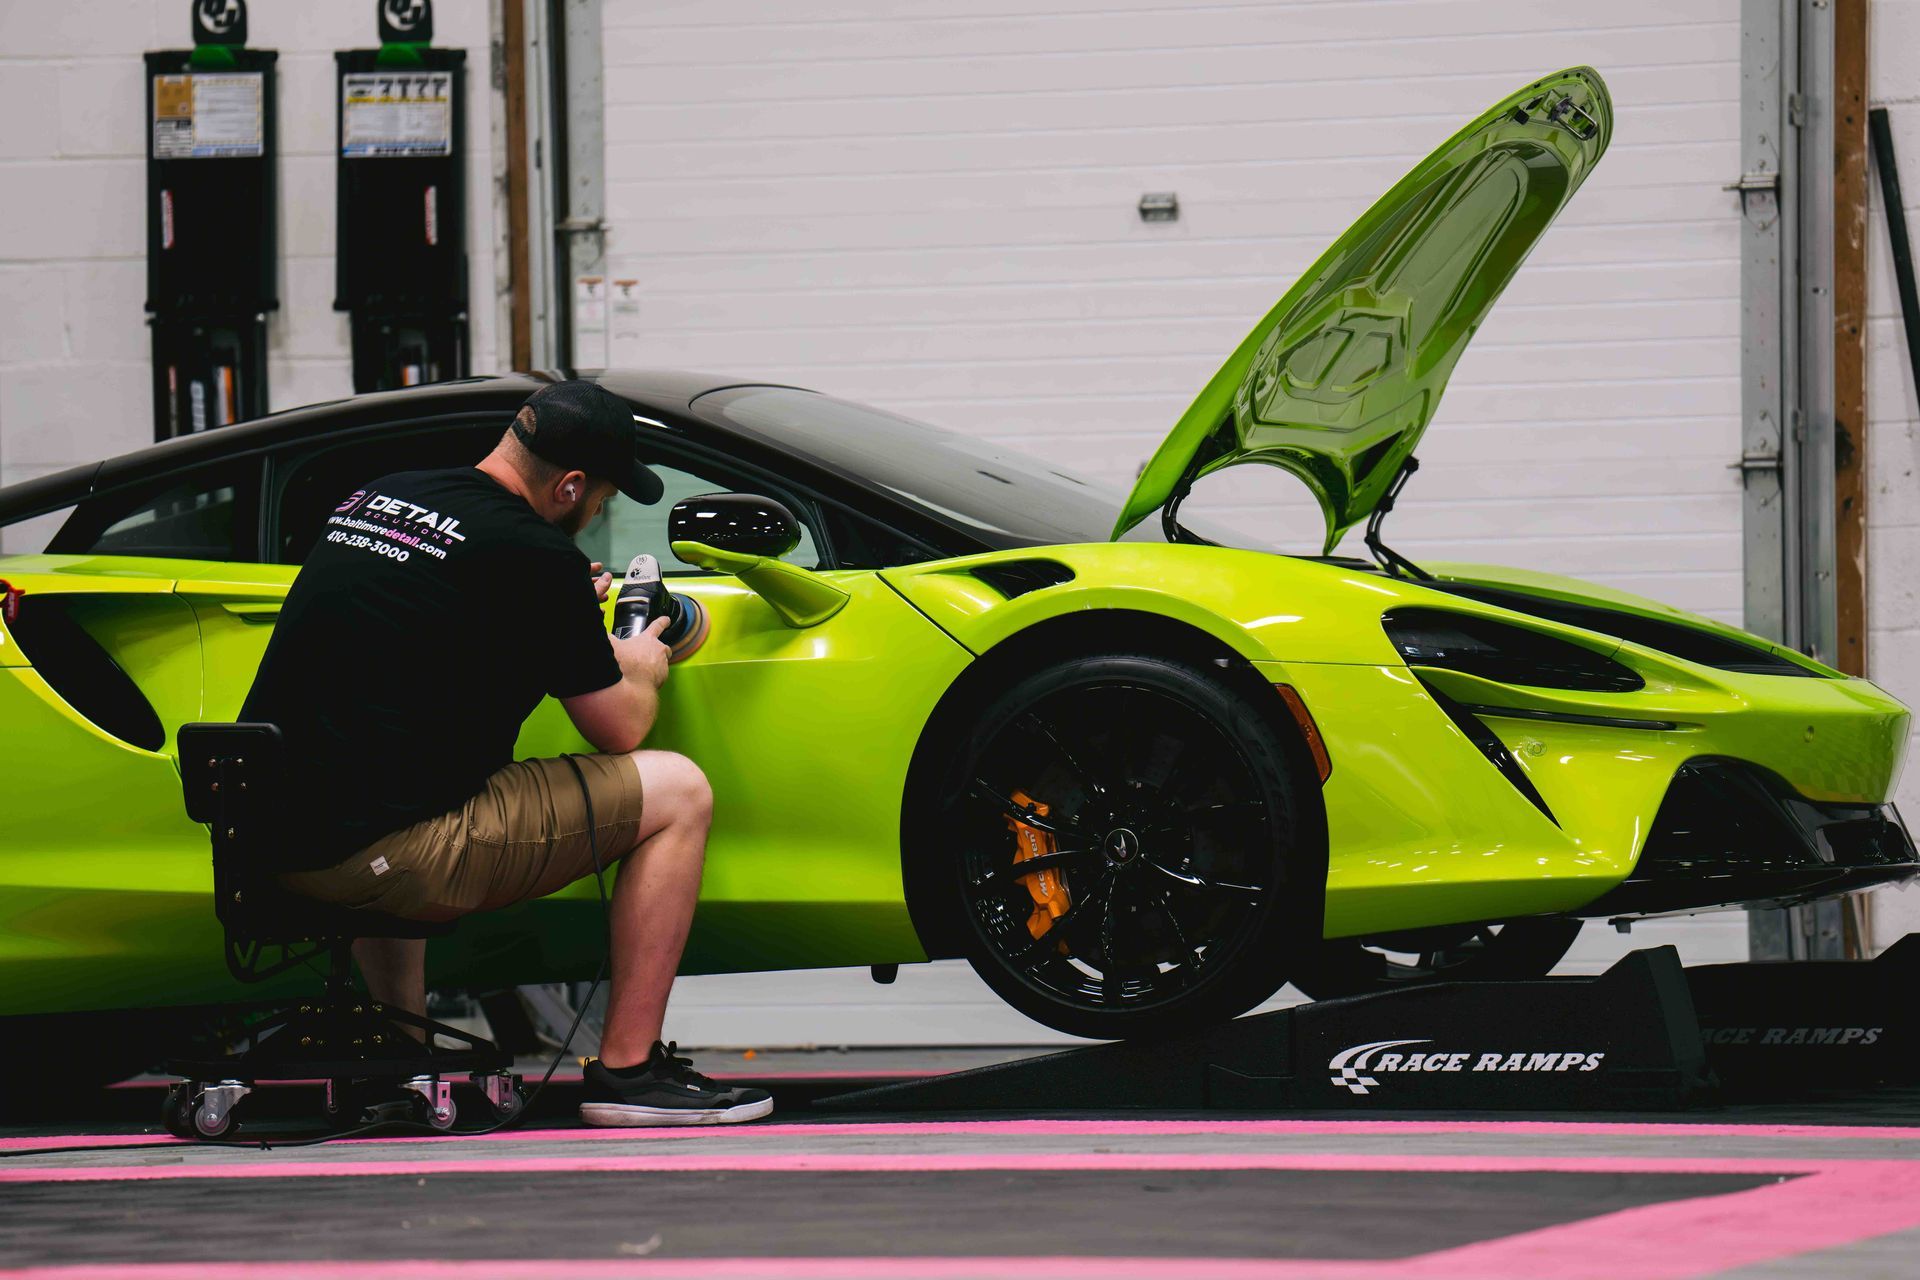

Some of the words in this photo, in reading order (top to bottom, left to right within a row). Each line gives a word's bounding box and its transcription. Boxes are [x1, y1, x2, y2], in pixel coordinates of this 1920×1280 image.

[364, 510, 453, 545] SOLUTIONS
[366, 494, 466, 542] DETAIL
[326, 530, 410, 562] 410-238-3000
[1699, 1027, 1757, 1045] ACE
[1759, 1027, 1884, 1045] RAMPS
[1372, 1052, 1470, 1072] RACE
[1472, 1052, 1605, 1072] RAMPS
